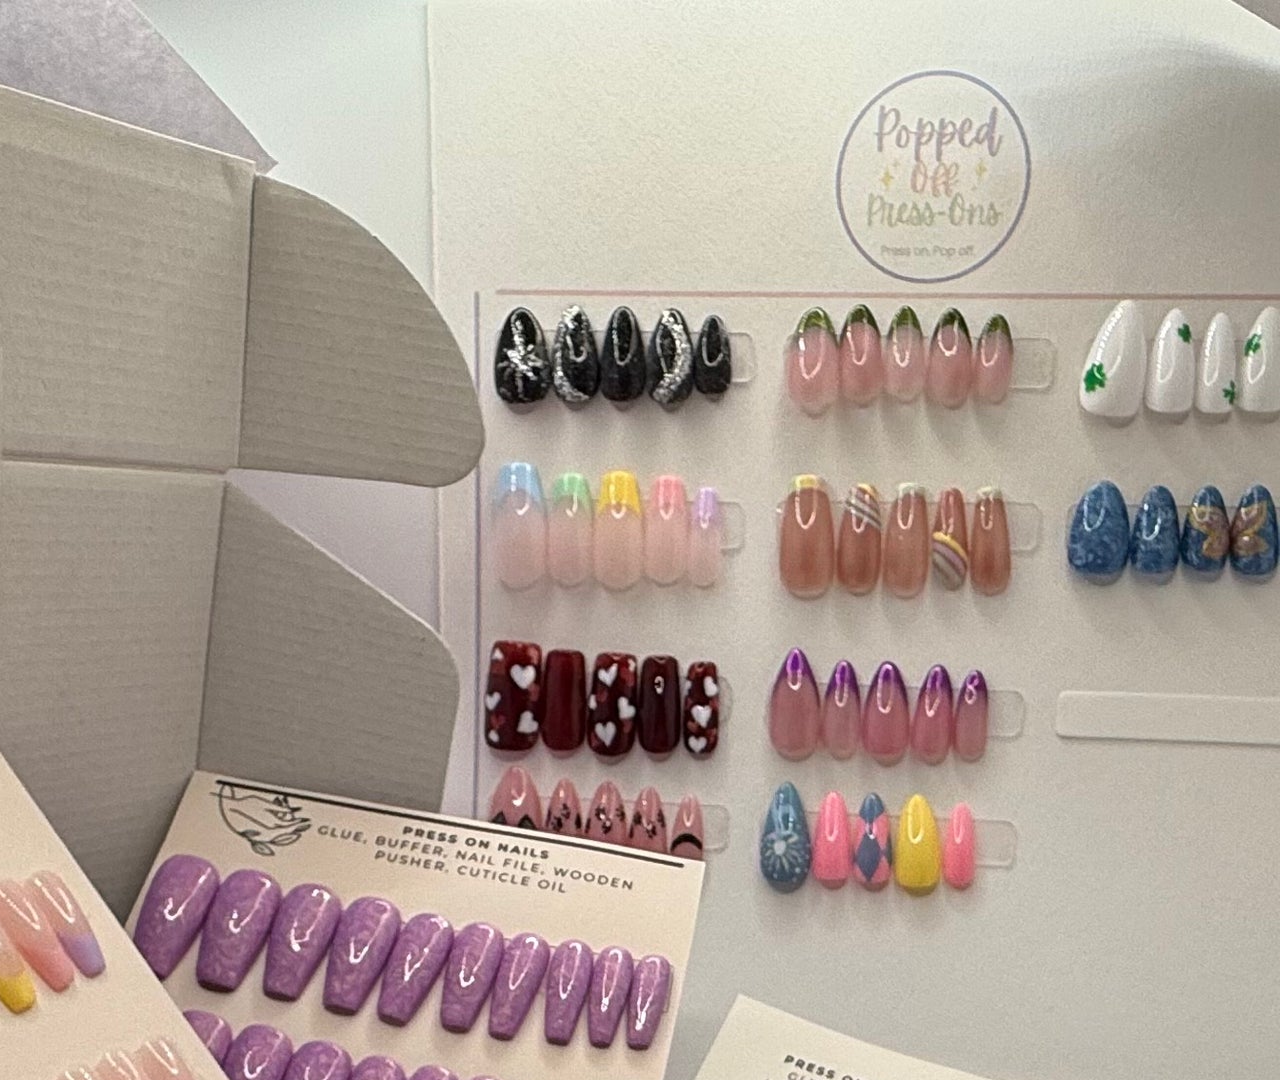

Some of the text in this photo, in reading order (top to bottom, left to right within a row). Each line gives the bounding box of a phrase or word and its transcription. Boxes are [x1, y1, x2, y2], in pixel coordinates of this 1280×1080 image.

[874, 105, 1003, 162] Popped
[910, 161, 959, 197] Off
[867, 192, 1003, 228] Press-Ons
[317, 825, 634, 890] GLUE, BUFFER, NAIL FILE, WOODEN
[402, 826, 549, 859] PRESS ON NAILS
[375, 850, 566, 893] PUSHER, CUTICLE OIL
[784, 1055, 836, 1079] PRESS
